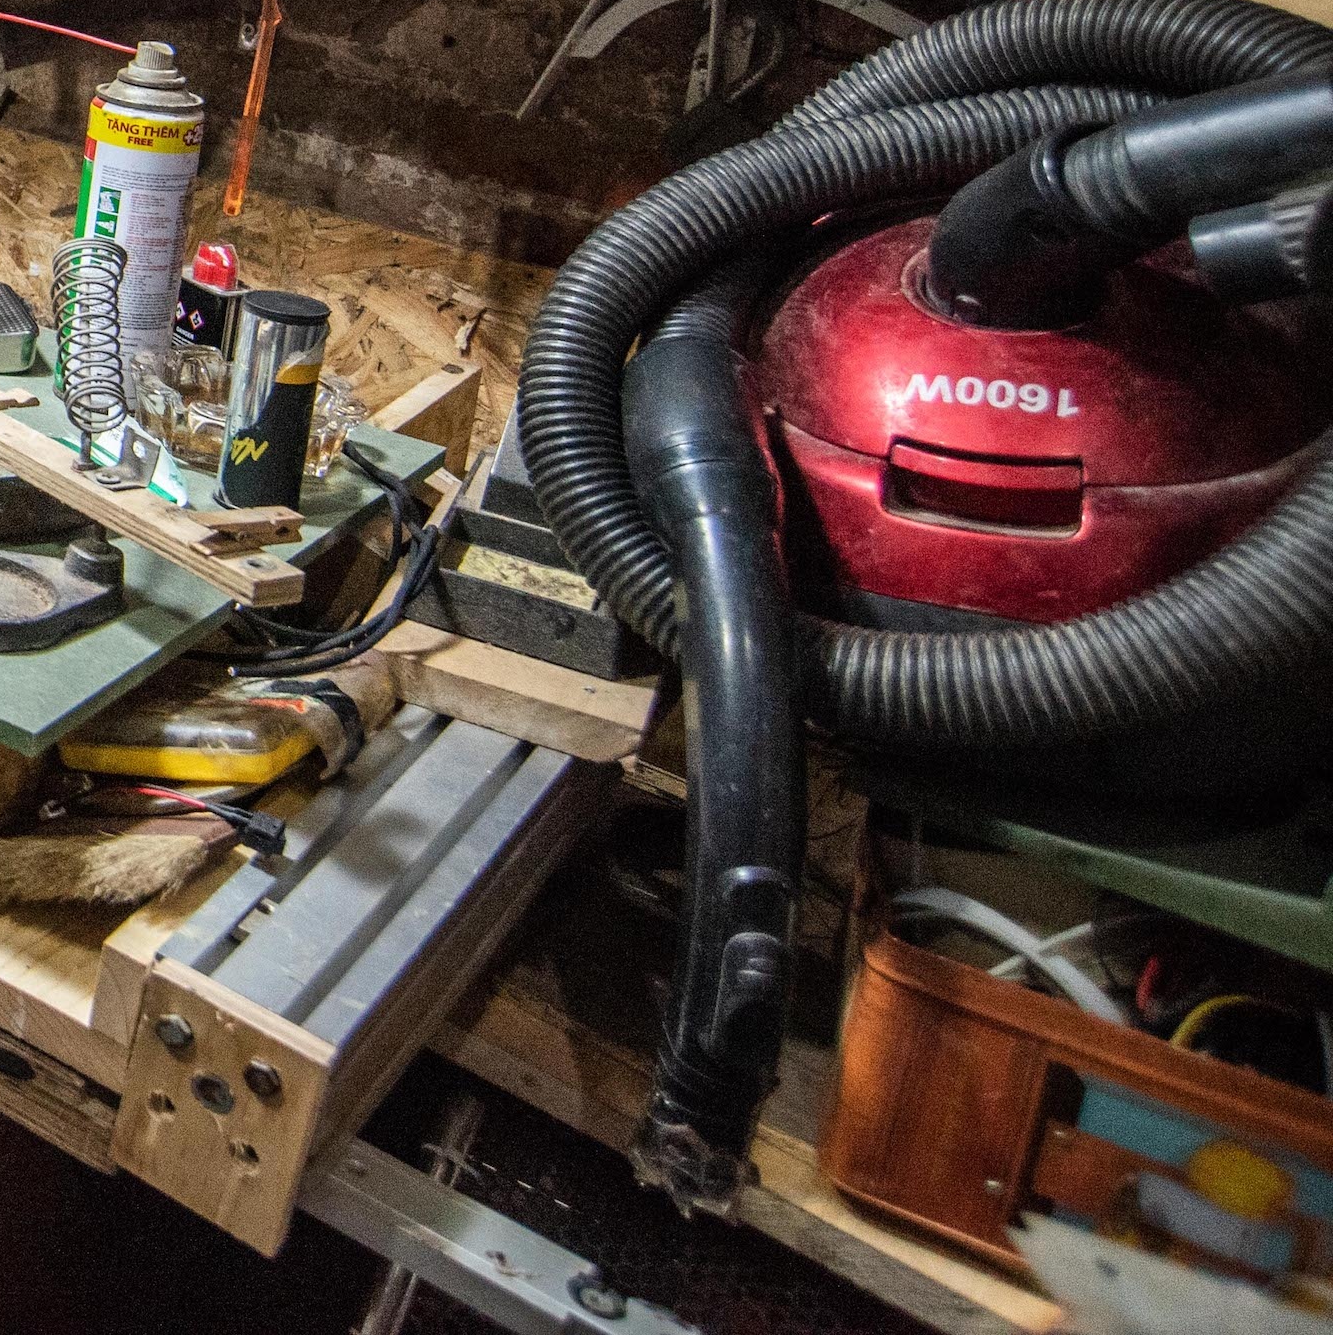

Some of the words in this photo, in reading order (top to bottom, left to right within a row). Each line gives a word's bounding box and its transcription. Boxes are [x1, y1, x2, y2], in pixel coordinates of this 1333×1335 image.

[142, 125, 180, 139] THÊM
[127, 136, 154, 147] FREE
[895, 373, 1080, 418] 1600W
